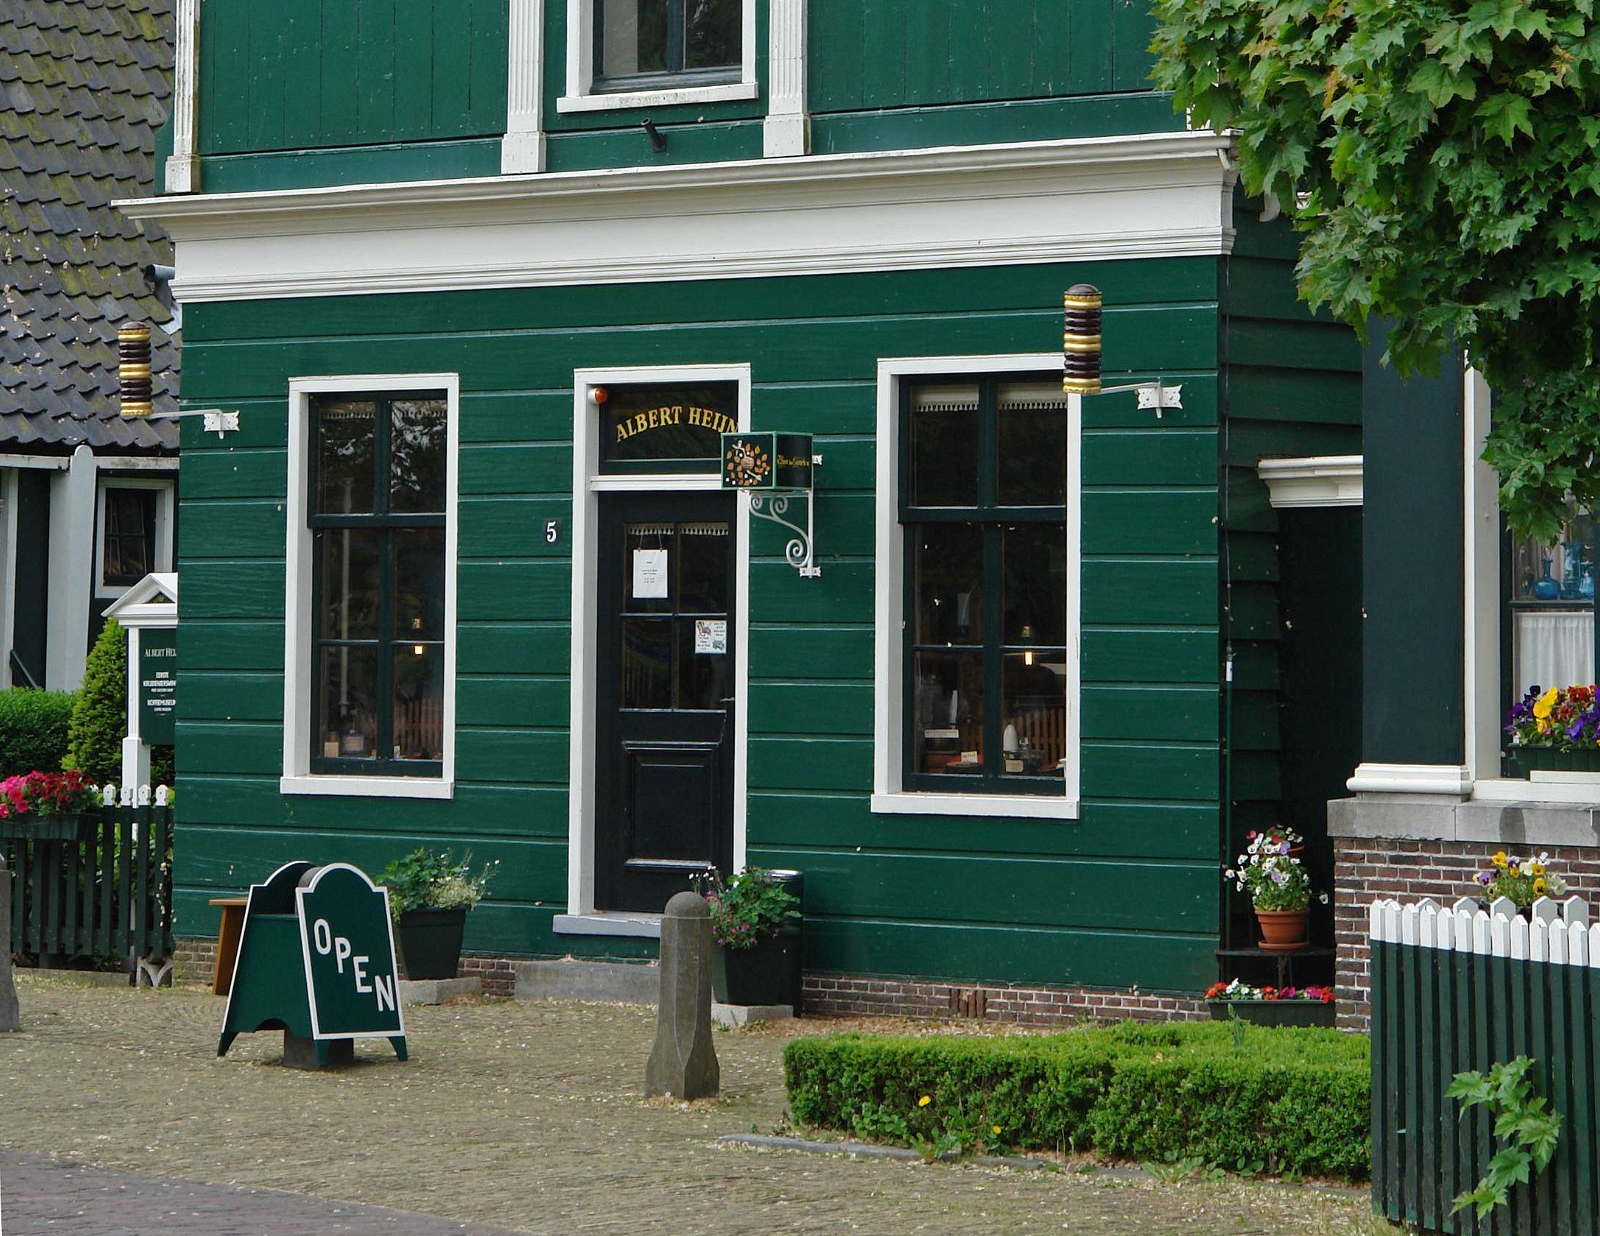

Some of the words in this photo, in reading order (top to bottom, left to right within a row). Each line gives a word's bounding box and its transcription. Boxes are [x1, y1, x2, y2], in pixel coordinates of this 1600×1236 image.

[616, 406, 682, 443] ALBERT
[546, 520, 557, 542] 5
[313, 918, 395, 1012] OPEN
